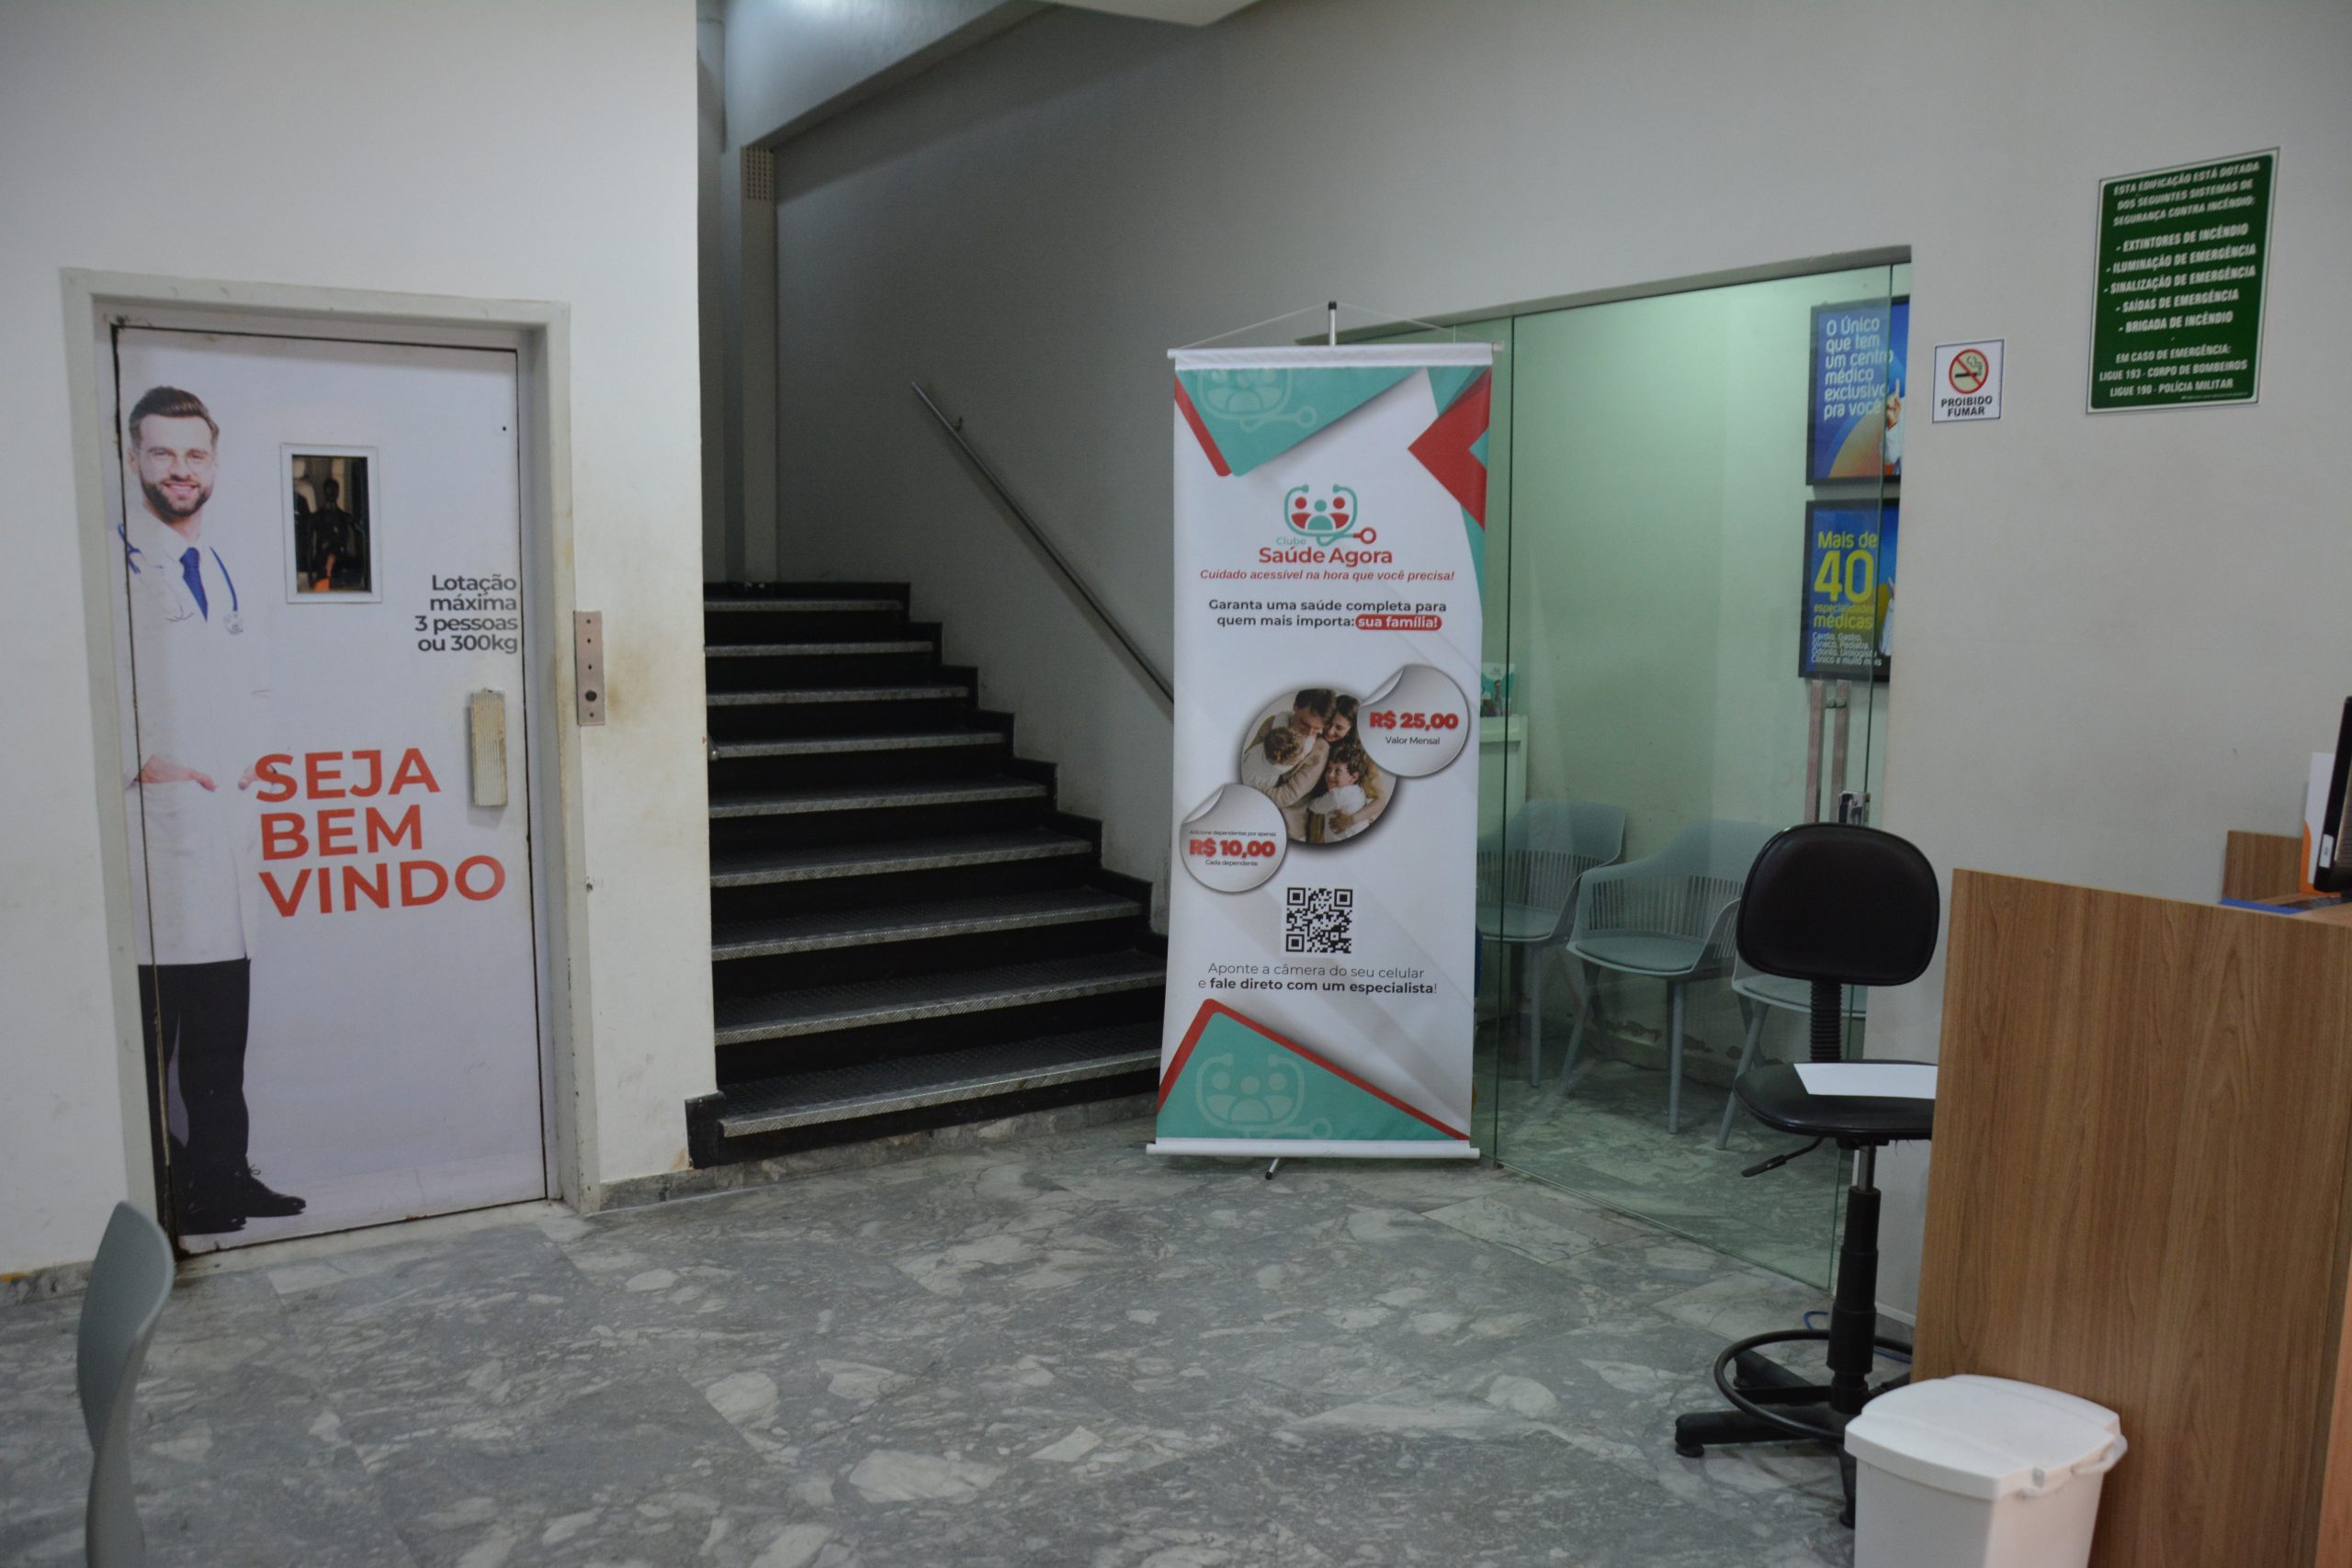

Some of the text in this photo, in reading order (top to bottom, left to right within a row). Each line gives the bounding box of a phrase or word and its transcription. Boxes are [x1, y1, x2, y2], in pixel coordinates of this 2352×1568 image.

[2113, 162, 2260, 196] ESTA EDIFICAÇÃO ESTÁ DOTADA
[2117, 178, 2254, 210] DOS SEGUINTES SISTEMAS DE
[2113, 209, 2166, 227] SEGURANÇA
[2168, 203, 2205, 218] CONTRA
[2122, 232, 2181, 253] EXTINTORES
[2182, 230, 2198, 243] DE
[2199, 222, 2249, 242] INCÊNDIO
[2113, 254, 2172, 273] ILUMINAÇÃO
[2174, 252, 2188, 265] DE
[2188, 243, 2256, 264] EMERGÊNCIA
[2109, 275, 2172, 294] SINALIZAÇÃO
[2174, 273, 2188, 287] DE
[2188, 265, 2256, 284] EMERGÊNCIA
[2122, 298, 2156, 313] SAÍDAS
[2158, 296, 2172, 309] DE
[2174, 288, 2239, 307] EMERGÊNCIA
[1826, 315, 1880, 336] O Único
[2125, 318, 2166, 333] BRIGADA
[2168, 316, 2183, 329] DE
[2185, 310, 2233, 327] INCÊNDIO
[1826, 334, 1880, 354] que tem
[2115, 344, 2231, 364] EM CASO DE EMERGÊNCIA:
[1826, 349, 1894, 369] um centro
[1825, 367, 1874, 386] médico
[2098, 370, 2124, 382] LIGUE
[2126, 368, 2142, 380] 193
[2146, 366, 2177, 378] CORPO
[2179, 364, 2191, 375] DE
[2192, 359, 2248, 373] BOMBEIROS
[1825, 382, 1889, 402] exclusivo
[2109, 385, 2133, 397] LIGUE
[2136, 384, 2153, 395] 190
[2158, 380, 2193, 394] POLÍCIA
[2194, 378, 2233, 391] MILITAR
[1824, 399, 1882, 421] pra você
[1940, 395, 1993, 408] PROIBIDO
[1948, 406, 1984, 417] FUMAR
[1275, 536, 1306, 546] Clube
[1818, 531, 1879, 549] Mais de
[1259, 546, 1393, 568] Saúde Agora
[432, 573, 517, 595] Lotação
[1200, 570, 1248, 580] Cuidado
[1250, 570, 1303, 580] acessível
[1306, 571, 1319, 580] na
[1323, 570, 1349, 581] hora
[1352, 571, 1374, 582] que
[1408, 570, 1455, 582] precisa!
[1814, 549, 1874, 603] 40
[430, 593, 516, 611] máxima
[1209, 599, 1447, 614] Garanta uma saúde completa para
[414, 615, 518, 636] 3 pessoas
[1217, 615, 1438, 628] quem mais importa: sua família!
[1814, 613, 1874, 630] médicas
[417, 634, 518, 654] ou 300kg
[1863, 658, 1883, 666] mis
[1369, 710, 1459, 731] R$ 25,00
[1409, 737, 1441, 745] Mensal
[254, 748, 441, 803] SEJA
[259, 805, 424, 861] BEM
[1190, 838, 1276, 859] R$ 10,00
[259, 855, 506, 918] VINDO
[1208, 963, 1424, 979] Aponte a câmera do seu celular
[1210, 977, 1237, 989] fale
[1240, 978, 1283, 990] direto
[1286, 981, 1317, 991] com
[1323, 983, 1345, 992] um
[1350, 981, 1437, 996] especialista!
